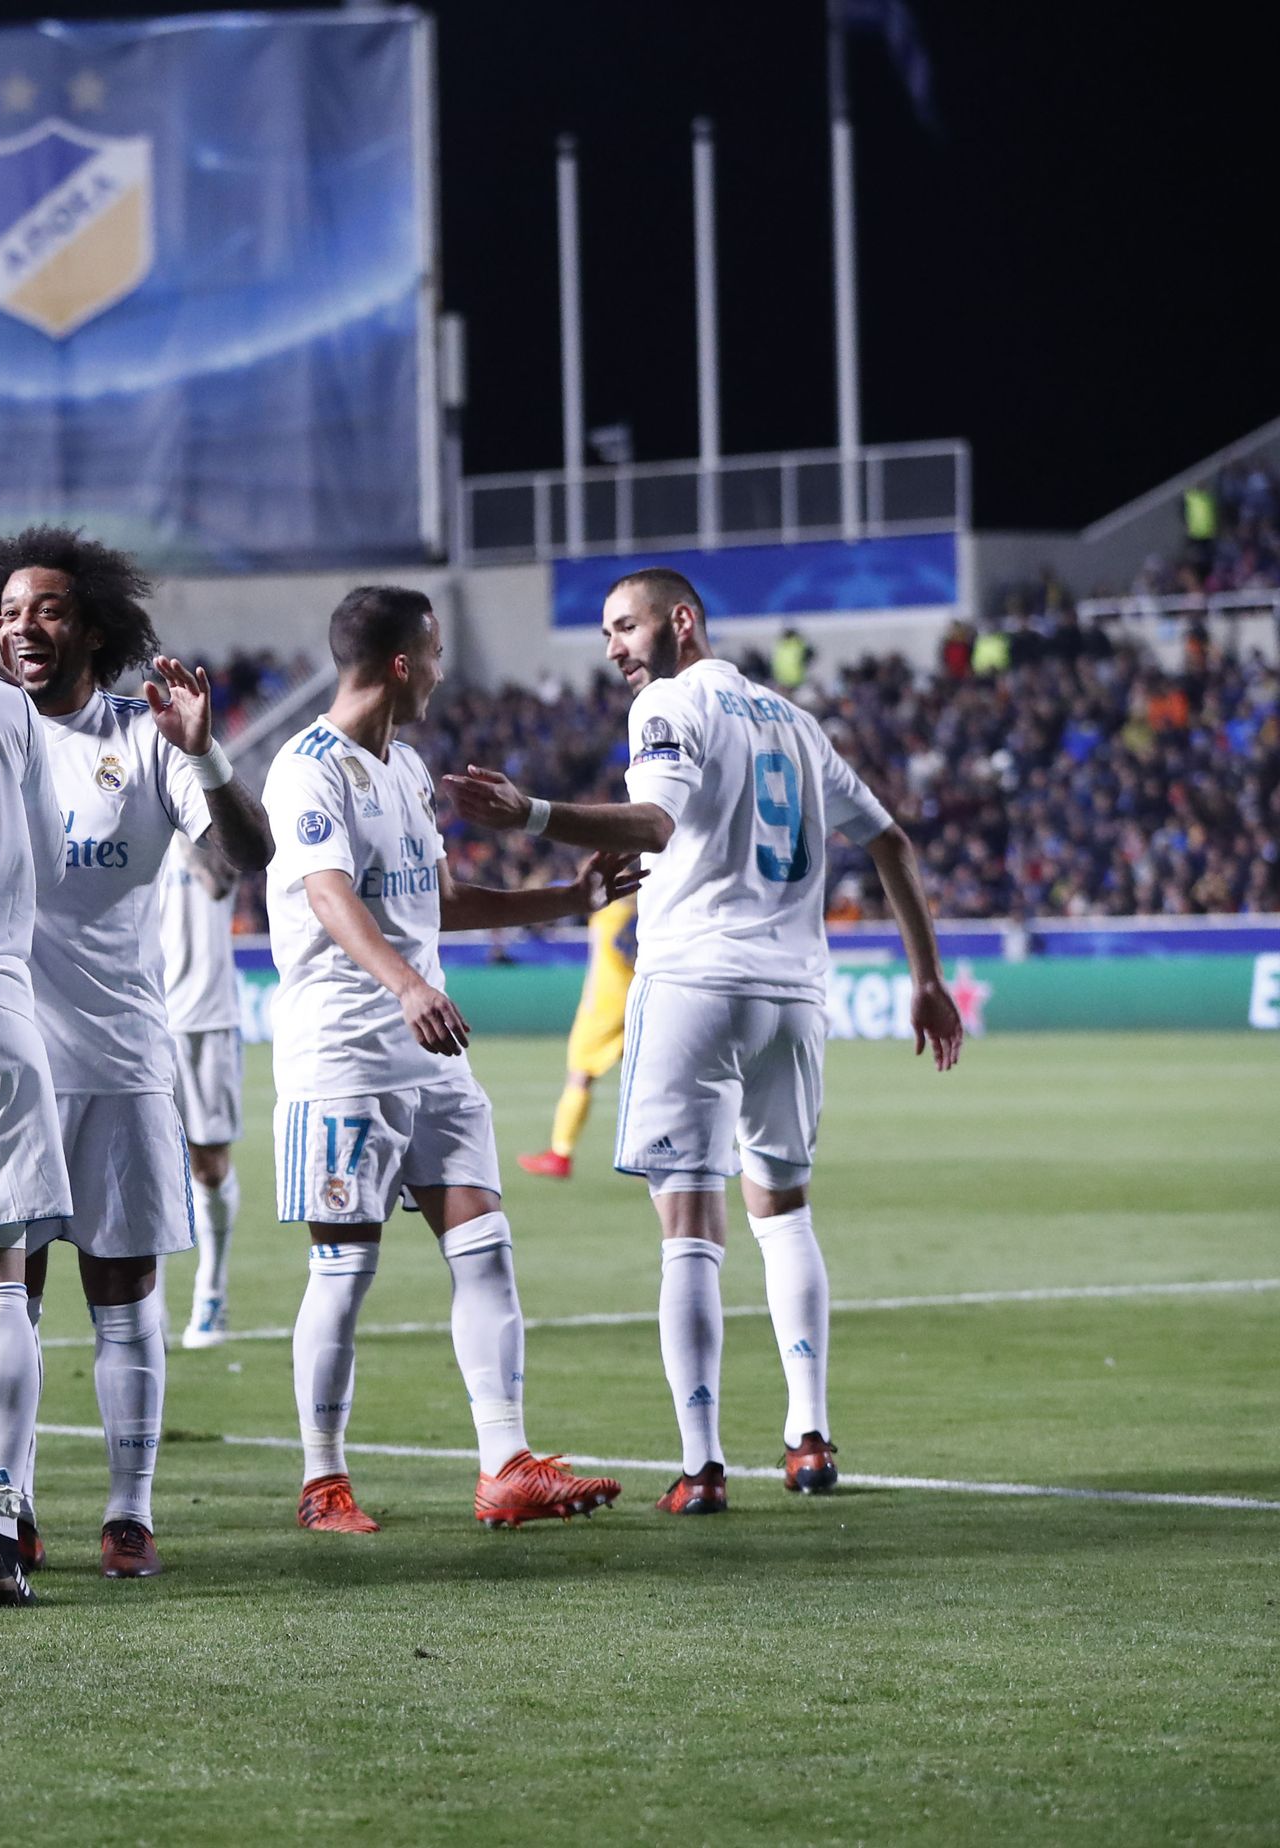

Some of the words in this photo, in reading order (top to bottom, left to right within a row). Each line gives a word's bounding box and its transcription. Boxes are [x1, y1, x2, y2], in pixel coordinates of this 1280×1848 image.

[755, 752, 812, 882] 9
[323, 1116, 371, 1174] 17
[120, 1438, 158, 1449] RMC
